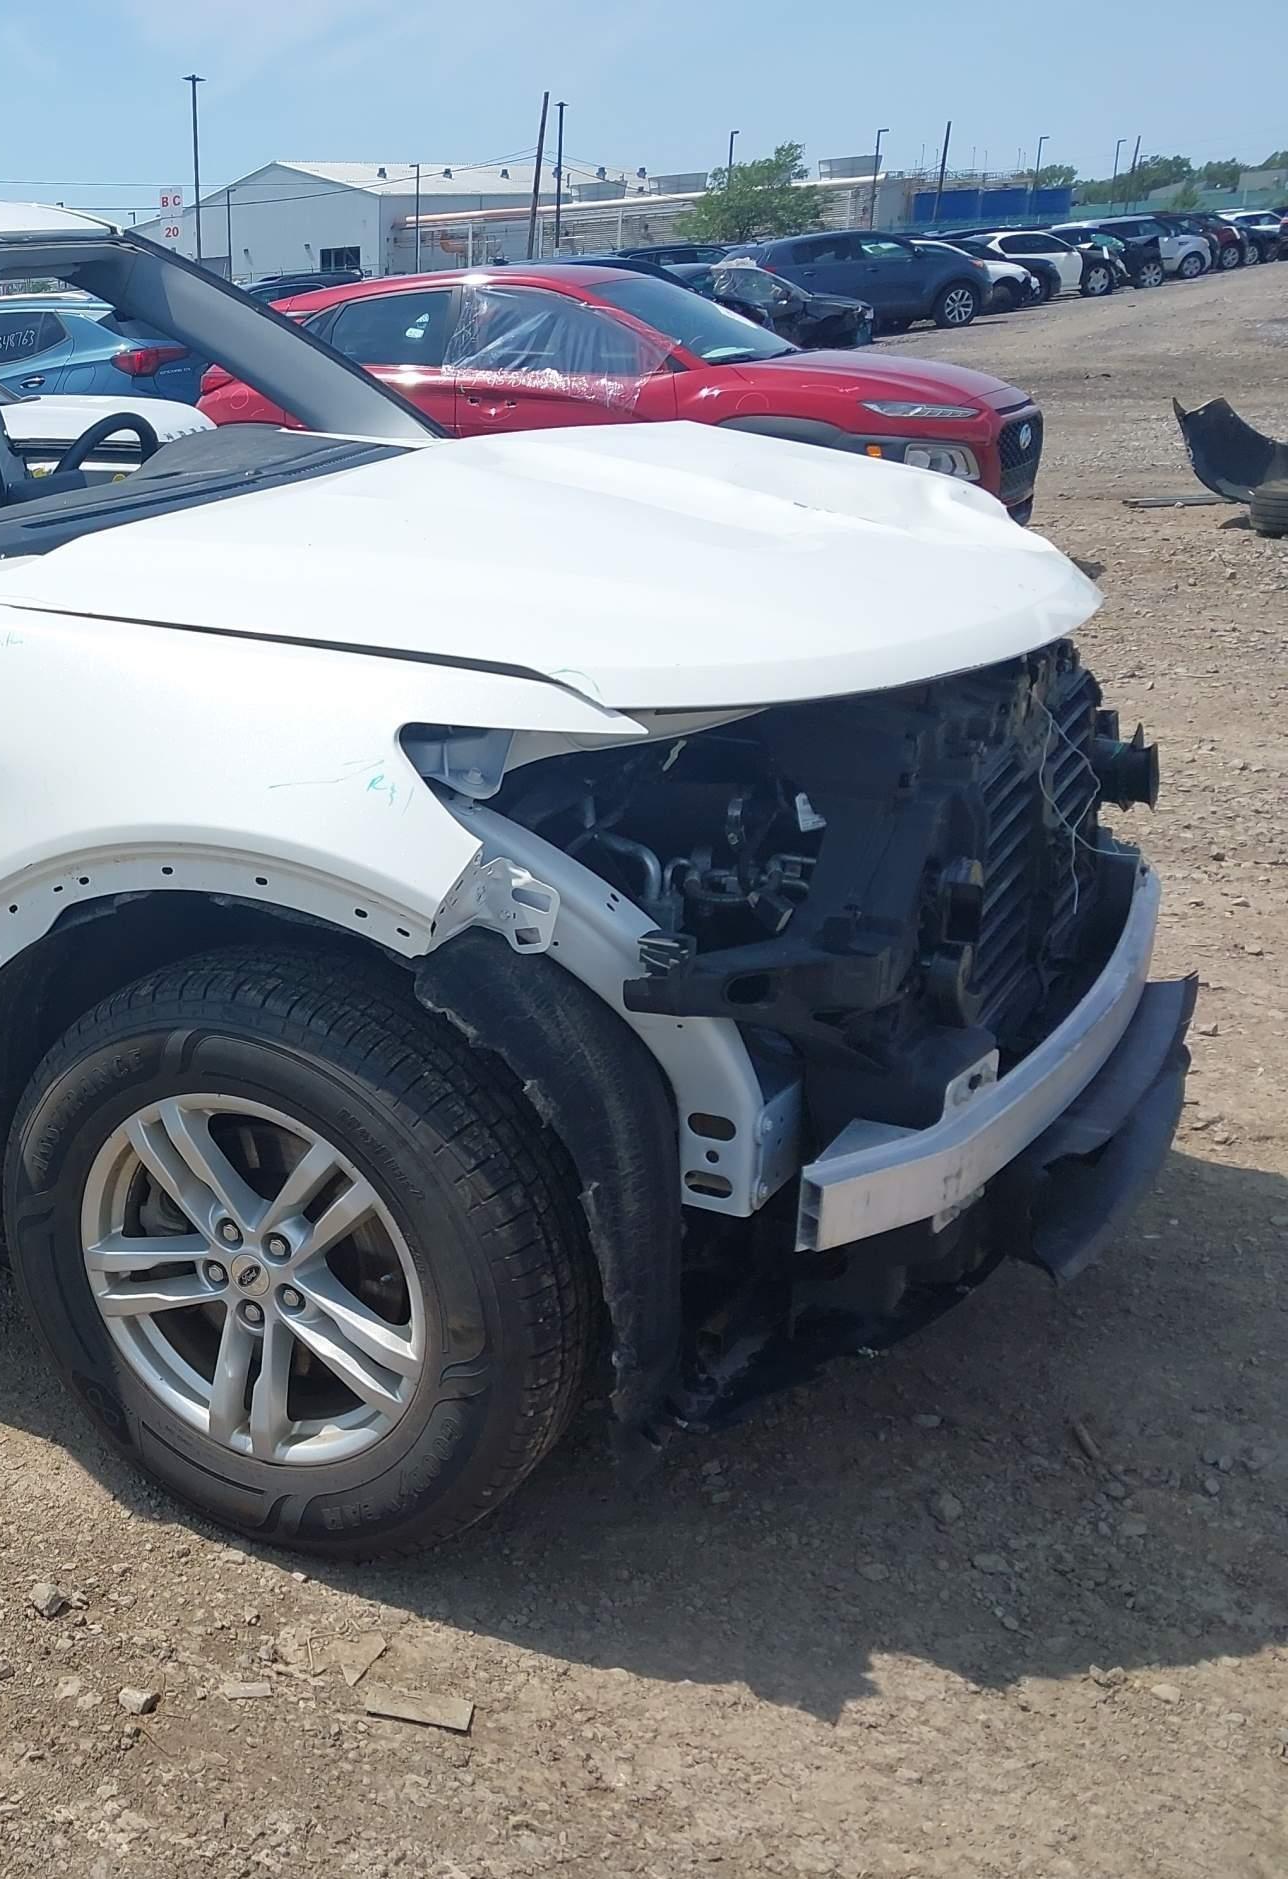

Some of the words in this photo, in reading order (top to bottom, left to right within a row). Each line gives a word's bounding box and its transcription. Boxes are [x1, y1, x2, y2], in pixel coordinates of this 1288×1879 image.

[161, 196, 169, 208] B
[172, 195, 181, 207] C
[164, 226, 180, 238] 20
